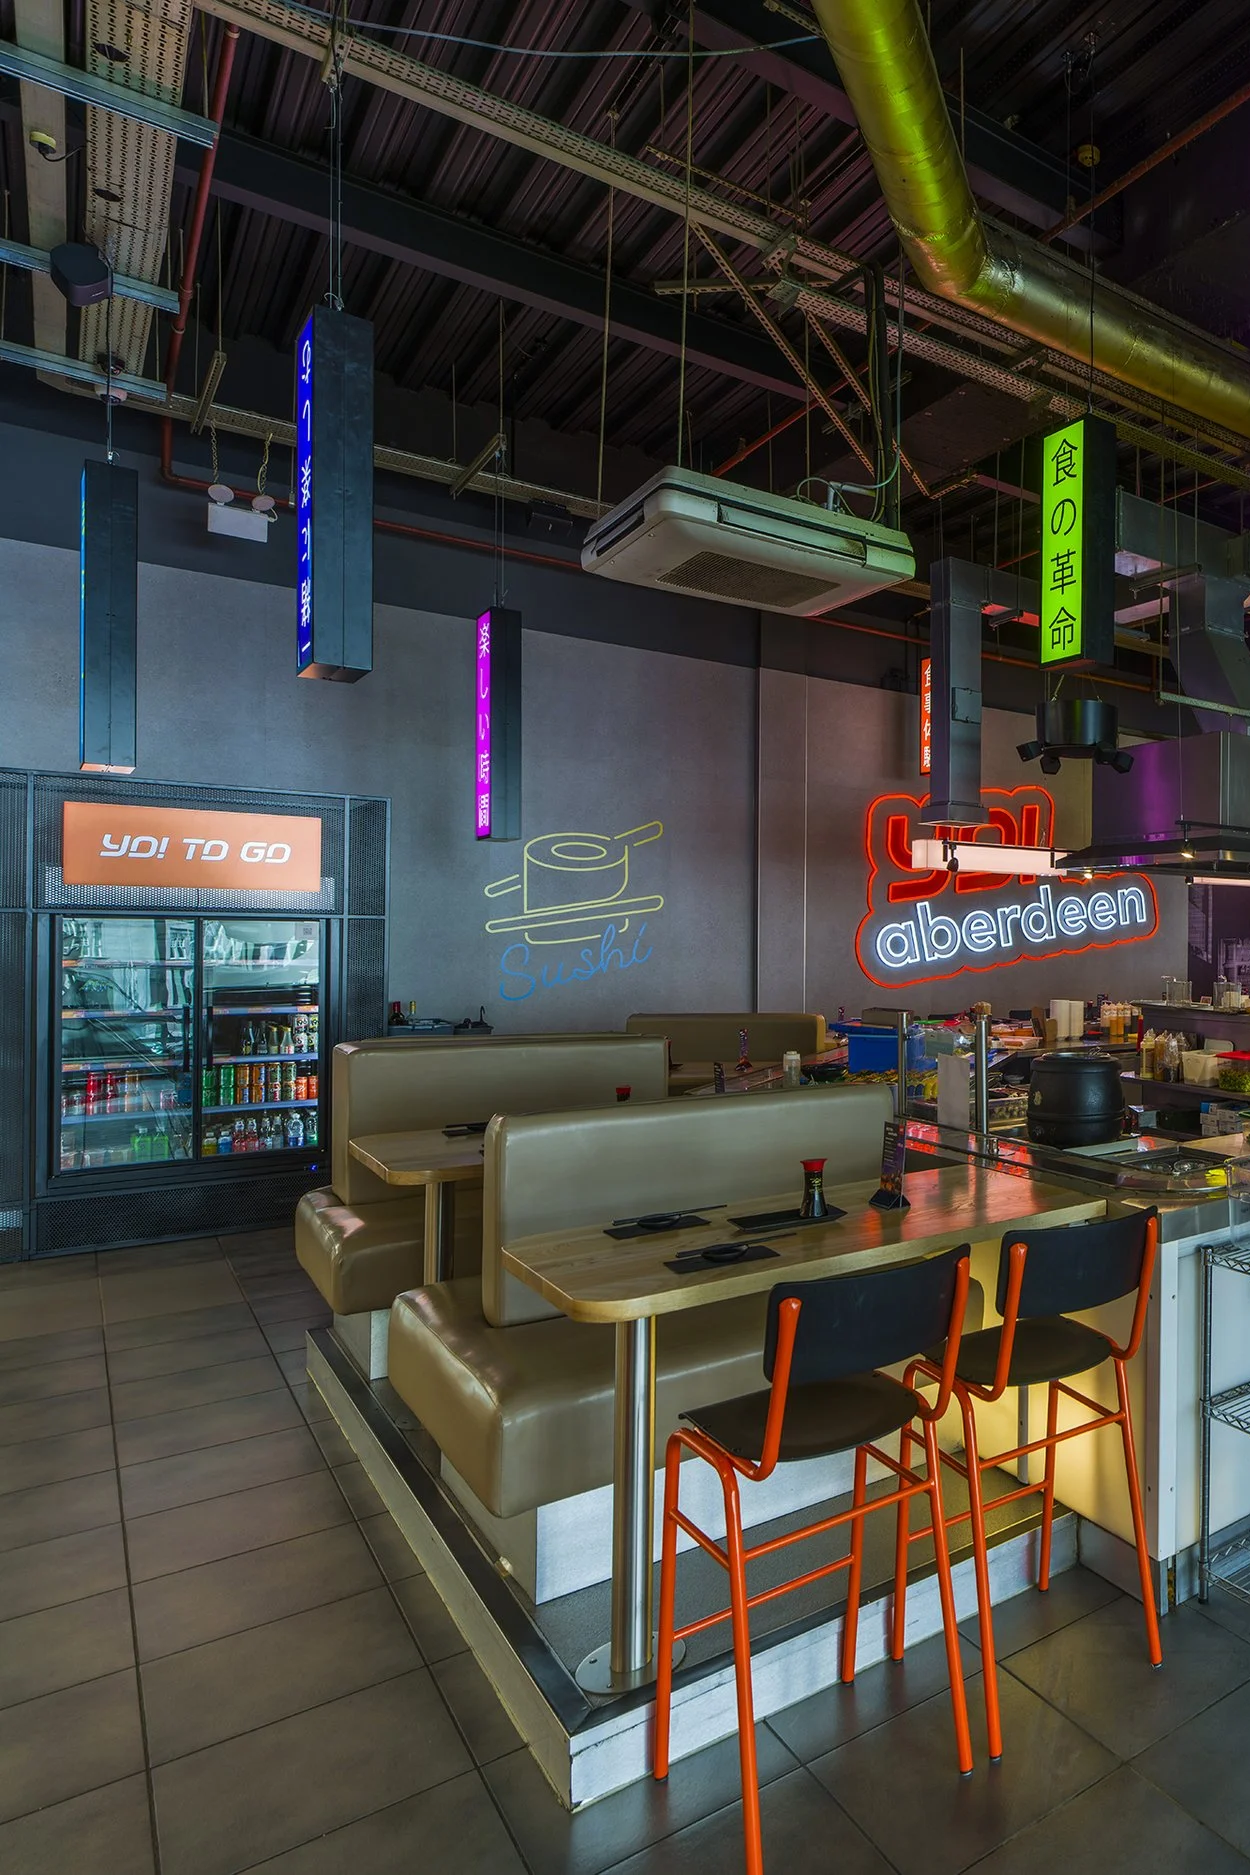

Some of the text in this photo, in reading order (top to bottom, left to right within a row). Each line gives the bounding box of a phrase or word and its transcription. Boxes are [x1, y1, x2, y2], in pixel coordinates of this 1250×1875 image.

[1049, 438, 1078, 650] 食の革命
[100, 833, 291, 865] YO! TO GO
[499, 922, 654, 1001] Sushi
[876, 884, 1146, 967] aberdeen
